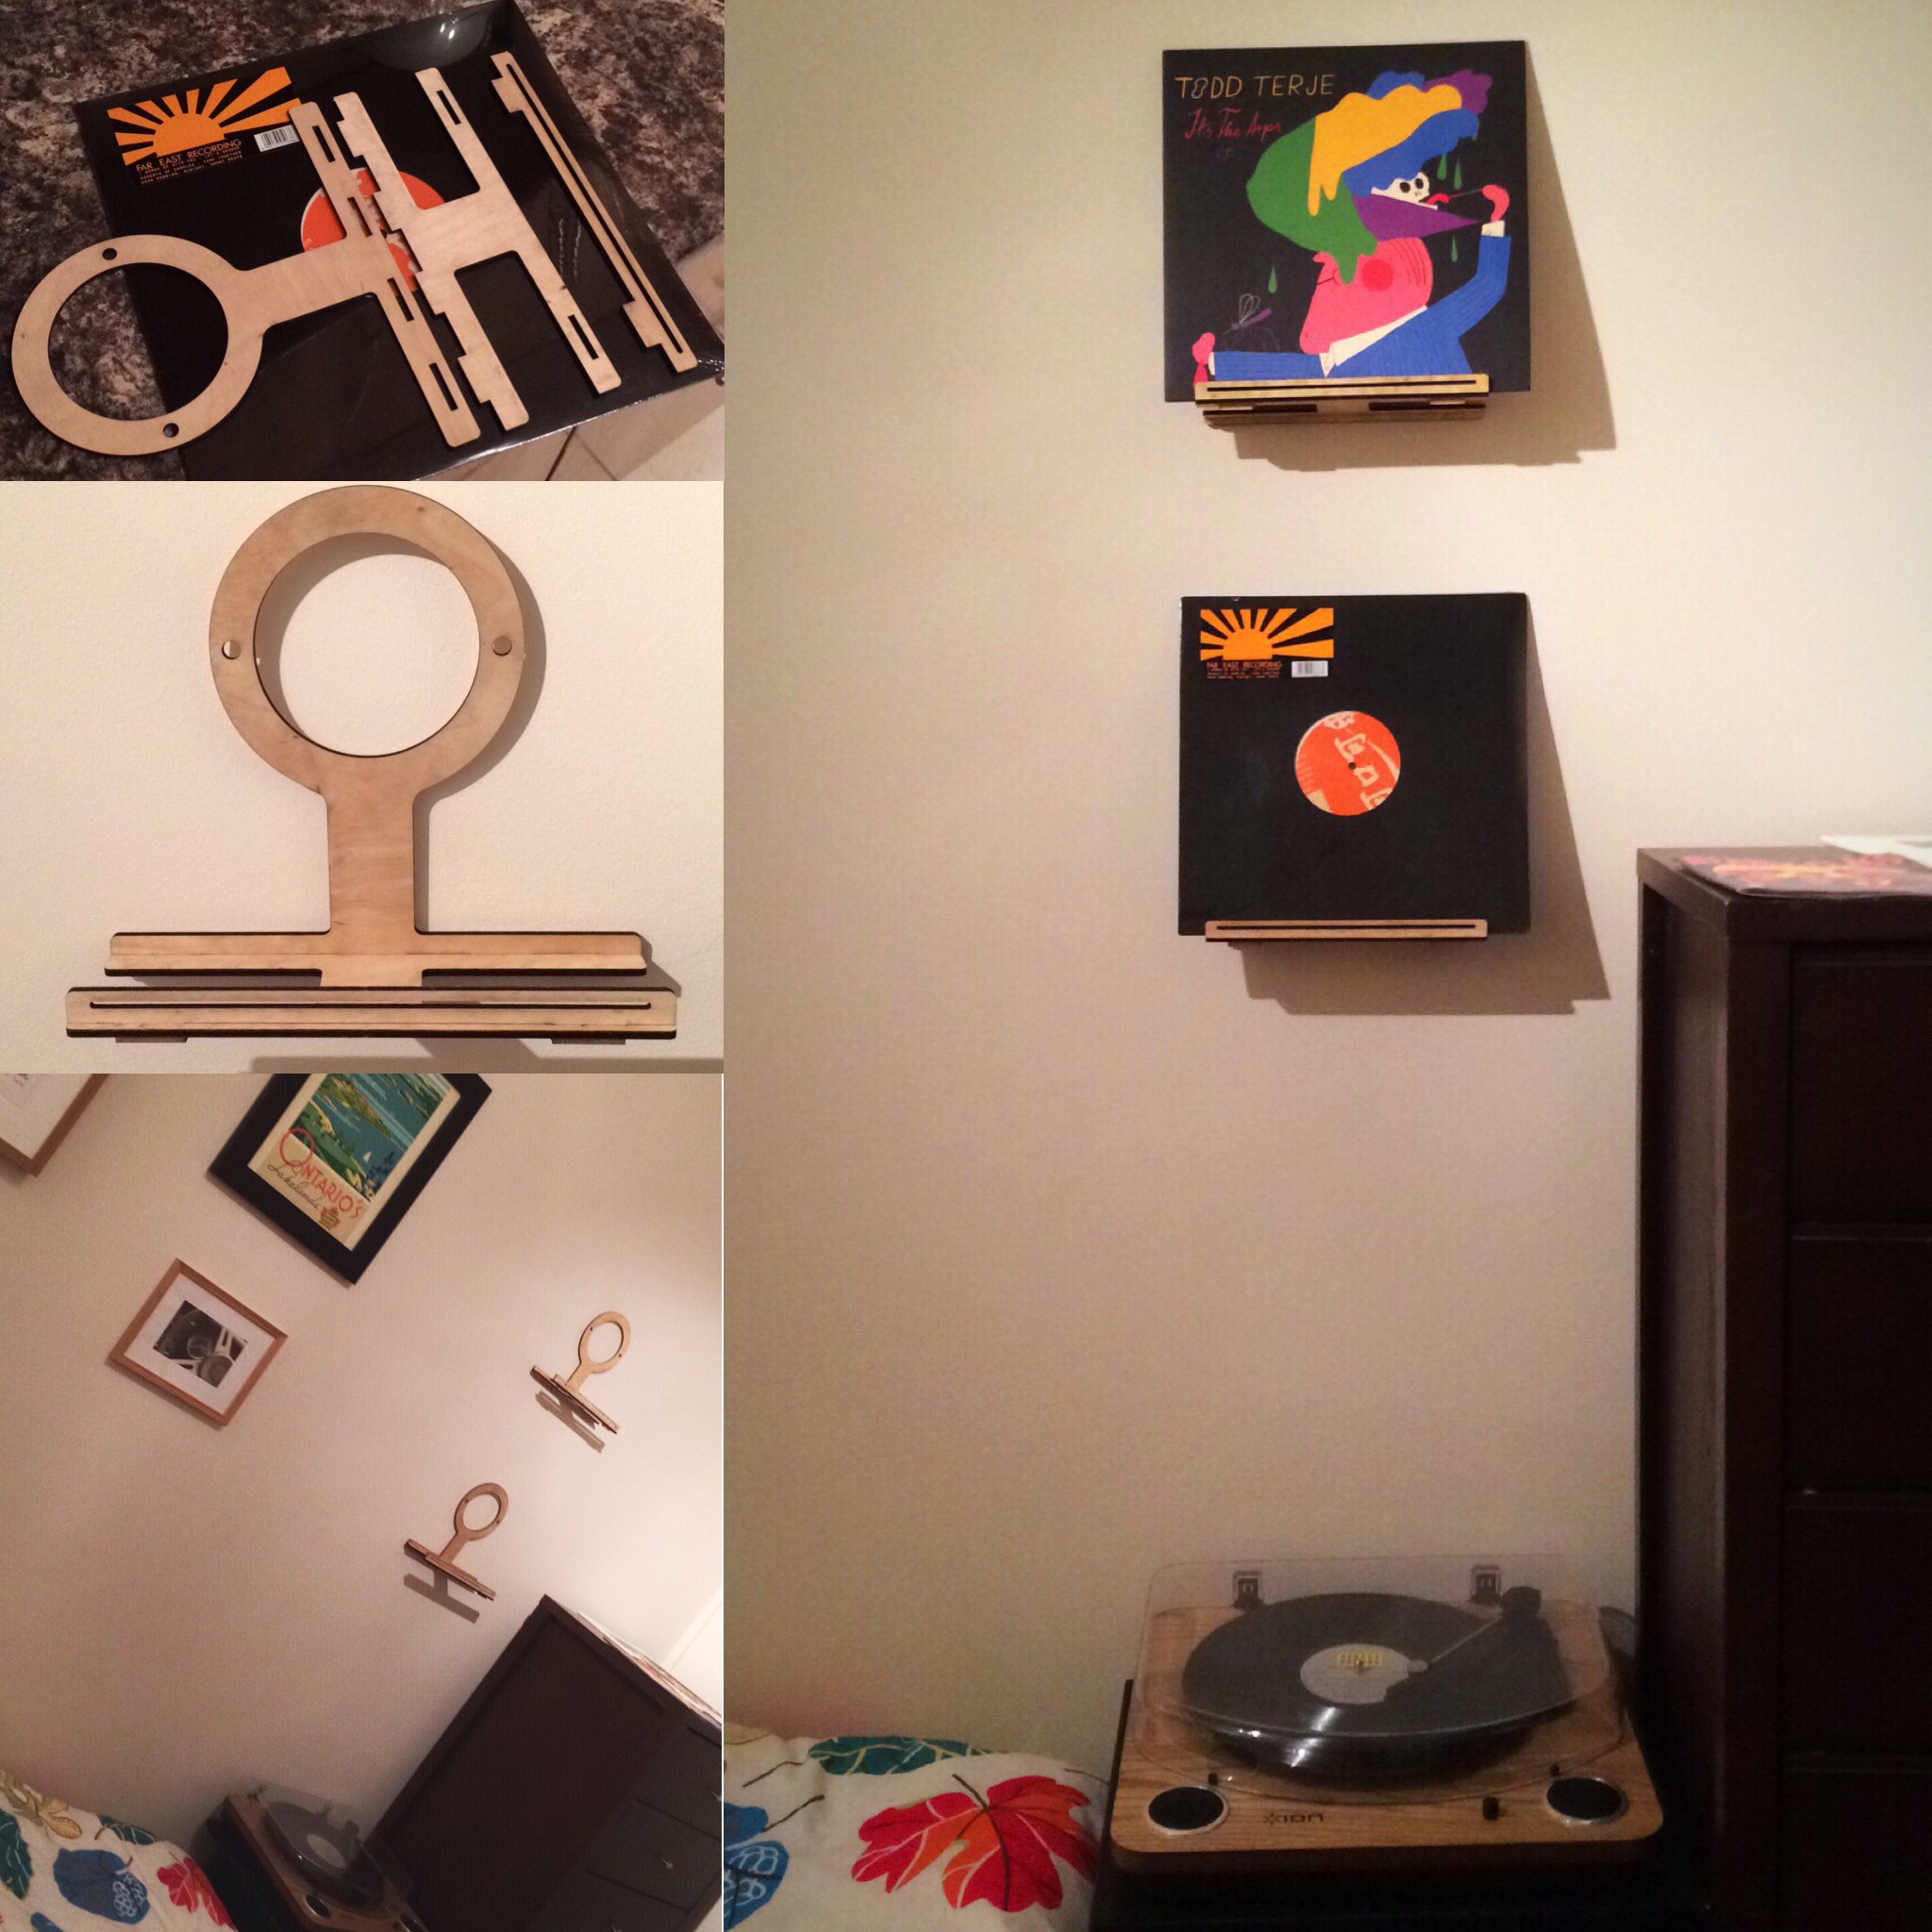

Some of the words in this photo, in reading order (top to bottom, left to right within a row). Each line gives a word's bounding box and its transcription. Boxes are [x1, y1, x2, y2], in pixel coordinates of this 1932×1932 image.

[1253, 74, 1336, 97] TERJE
[136, 161, 154, 173] FAR
[158, 154, 182, 167] EAST
[187, 139, 242, 158] RECORDING
[279, 1127, 365, 1219] ONTARIO'S
